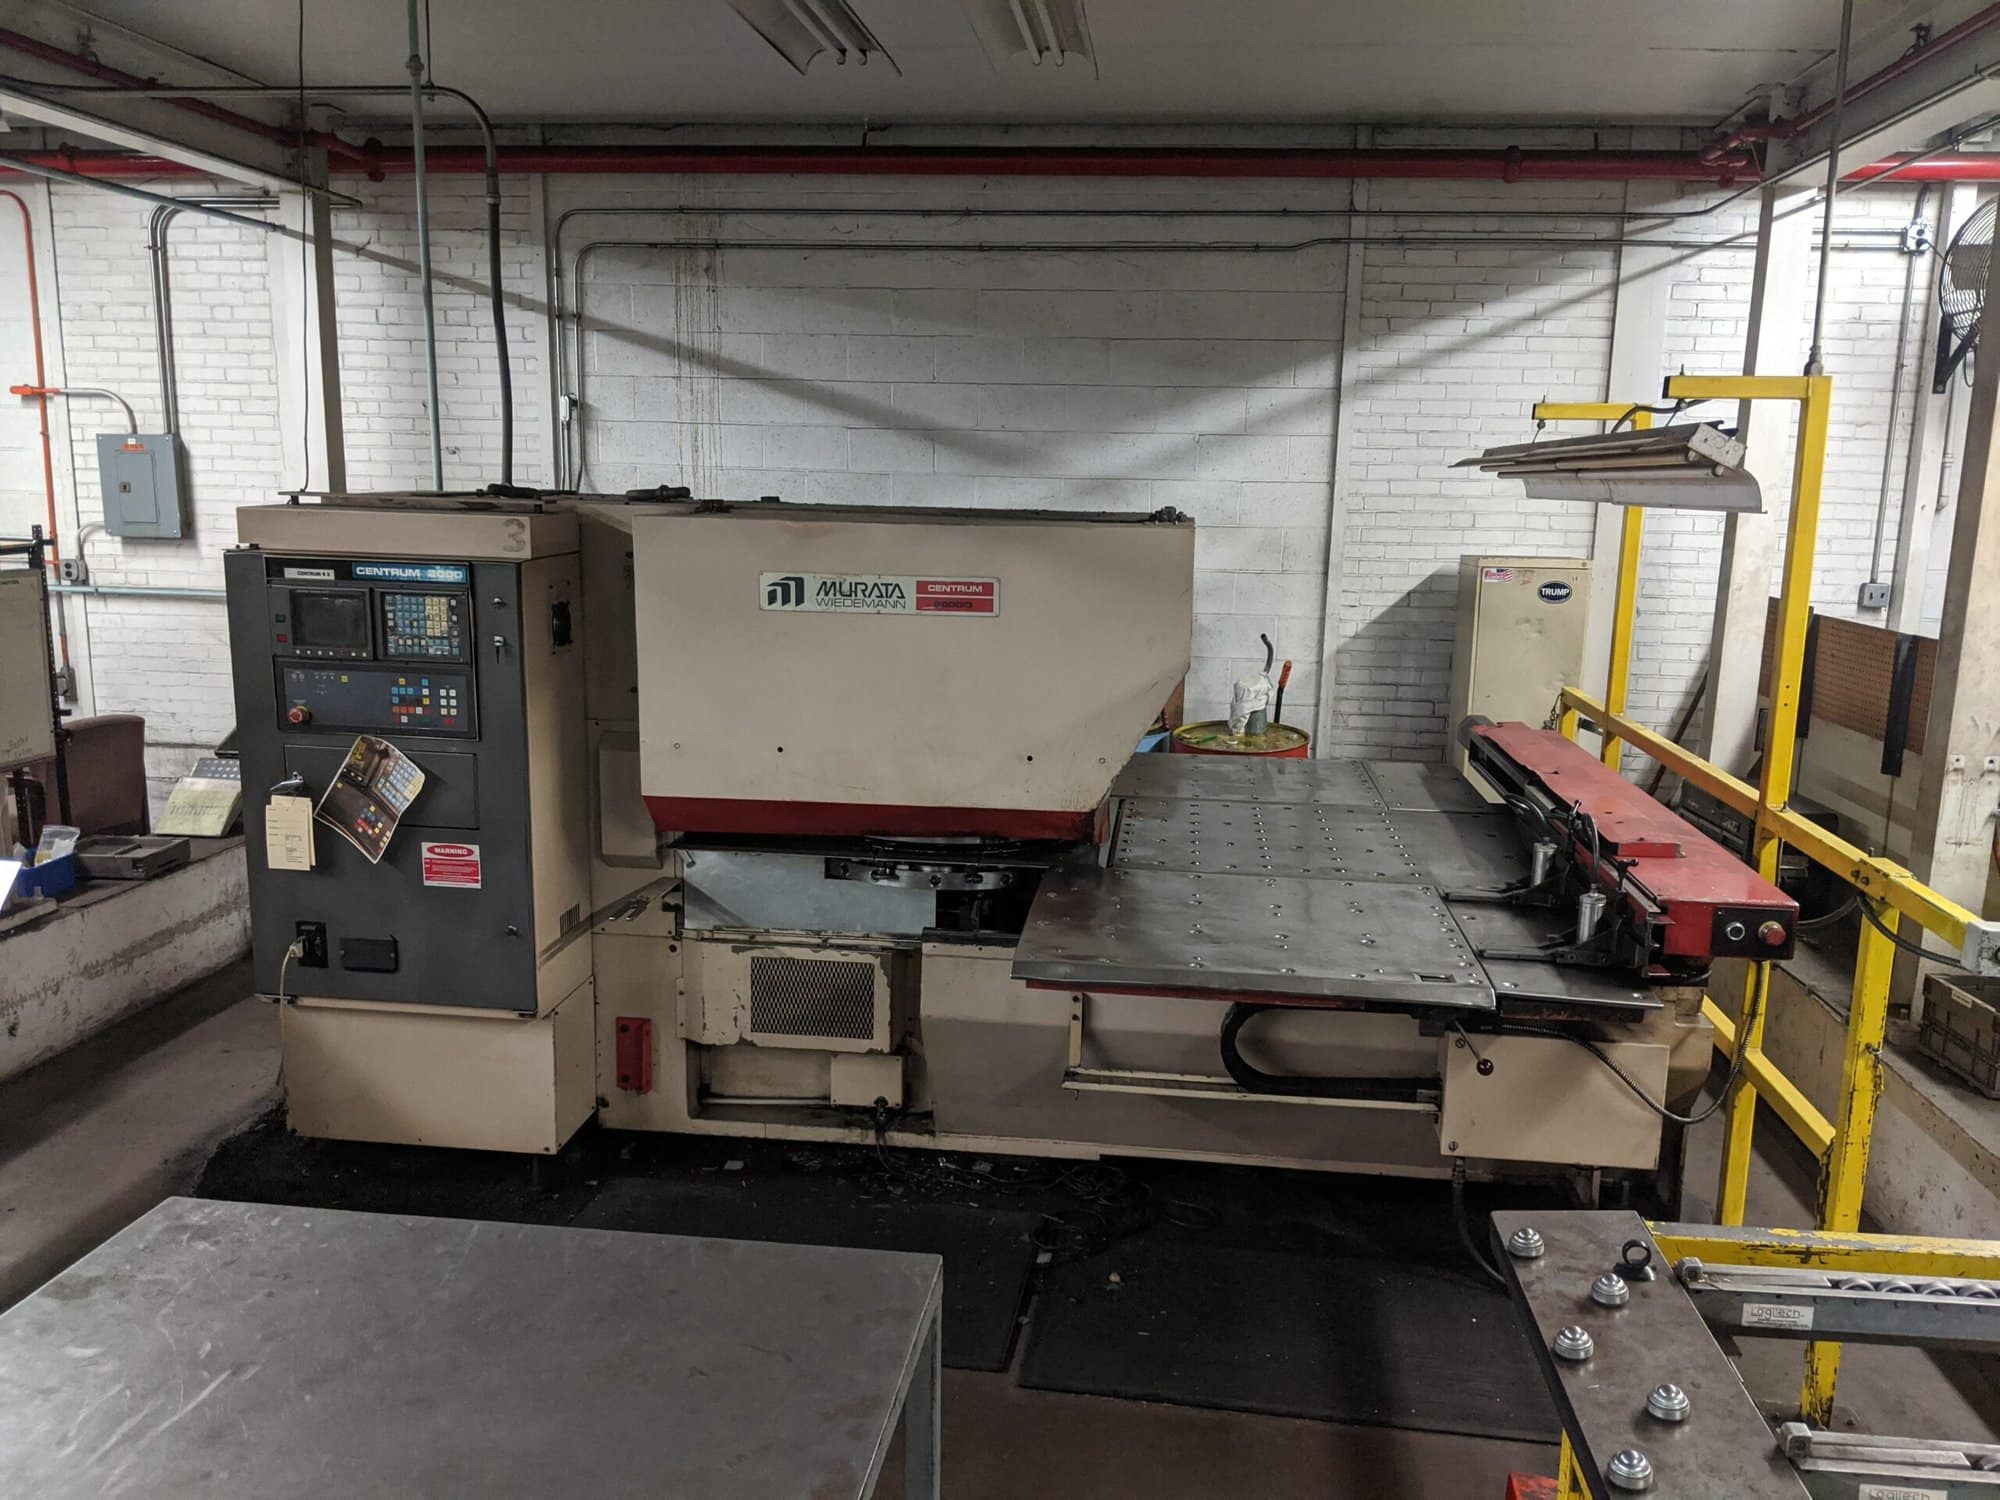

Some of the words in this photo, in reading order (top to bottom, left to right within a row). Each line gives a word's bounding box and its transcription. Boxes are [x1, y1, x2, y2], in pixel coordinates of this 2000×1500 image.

[355, 566, 420, 578] CENTRUM
[816, 581, 905, 599] MURATA
[927, 584, 983, 593] CENTRUM
[1541, 587, 1570, 596] TRUMP
[816, 598, 906, 609] WIEDEMANN
[433, 847, 468, 855] WARNING
